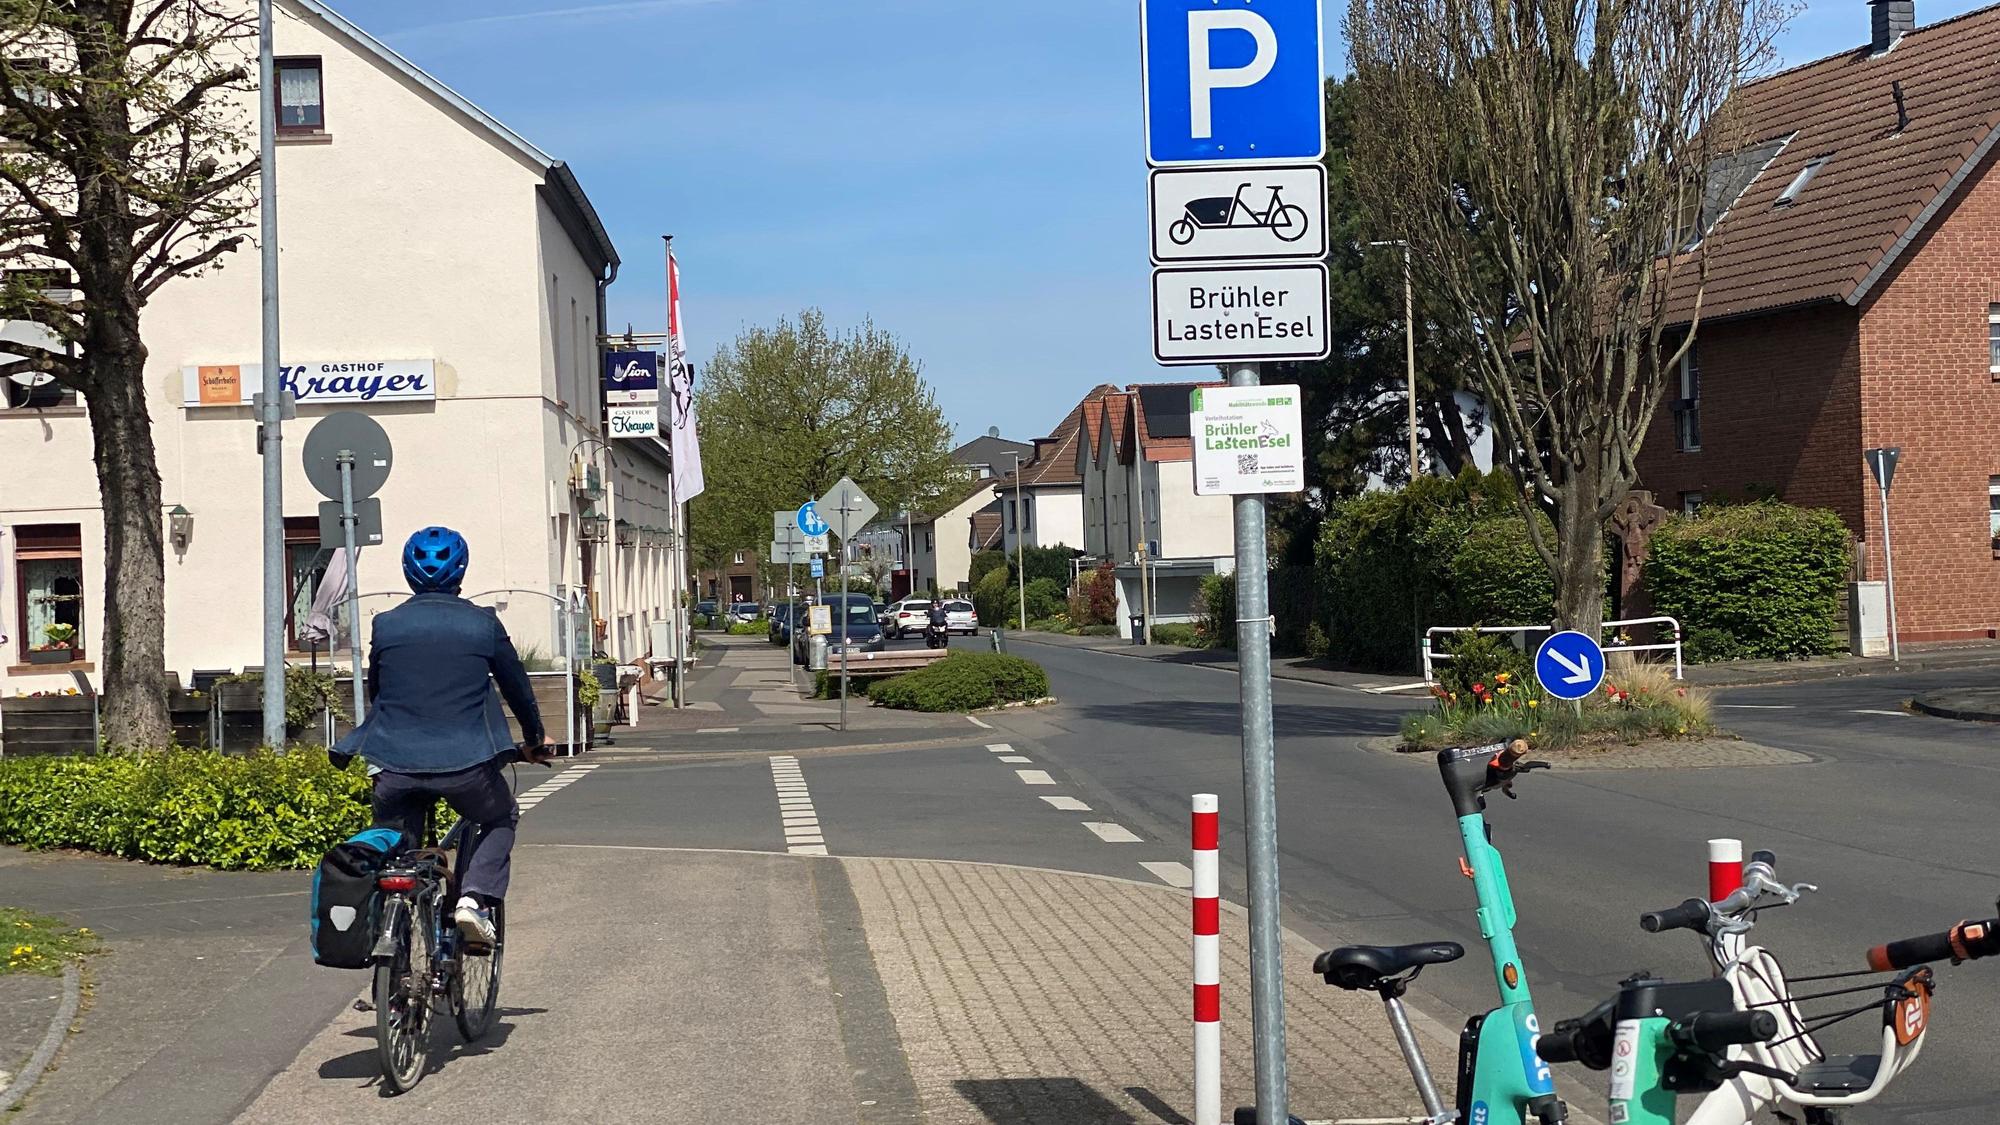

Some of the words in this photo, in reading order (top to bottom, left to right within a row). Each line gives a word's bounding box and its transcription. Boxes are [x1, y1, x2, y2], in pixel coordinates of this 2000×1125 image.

[1188, 9, 1278, 139] P
[1190, 286, 1289, 309] Brühler
[1168, 316, 1314, 341] LastenEsel
[321, 362, 385, 373] GASTHOF
[612, 360, 651, 382] Sion
[279, 366, 428, 401] Krayer
[612, 416, 655, 434] Krayer
[1205, 422, 1258, 435] Brühler
[1206, 434, 1290, 450] LastenEsel
